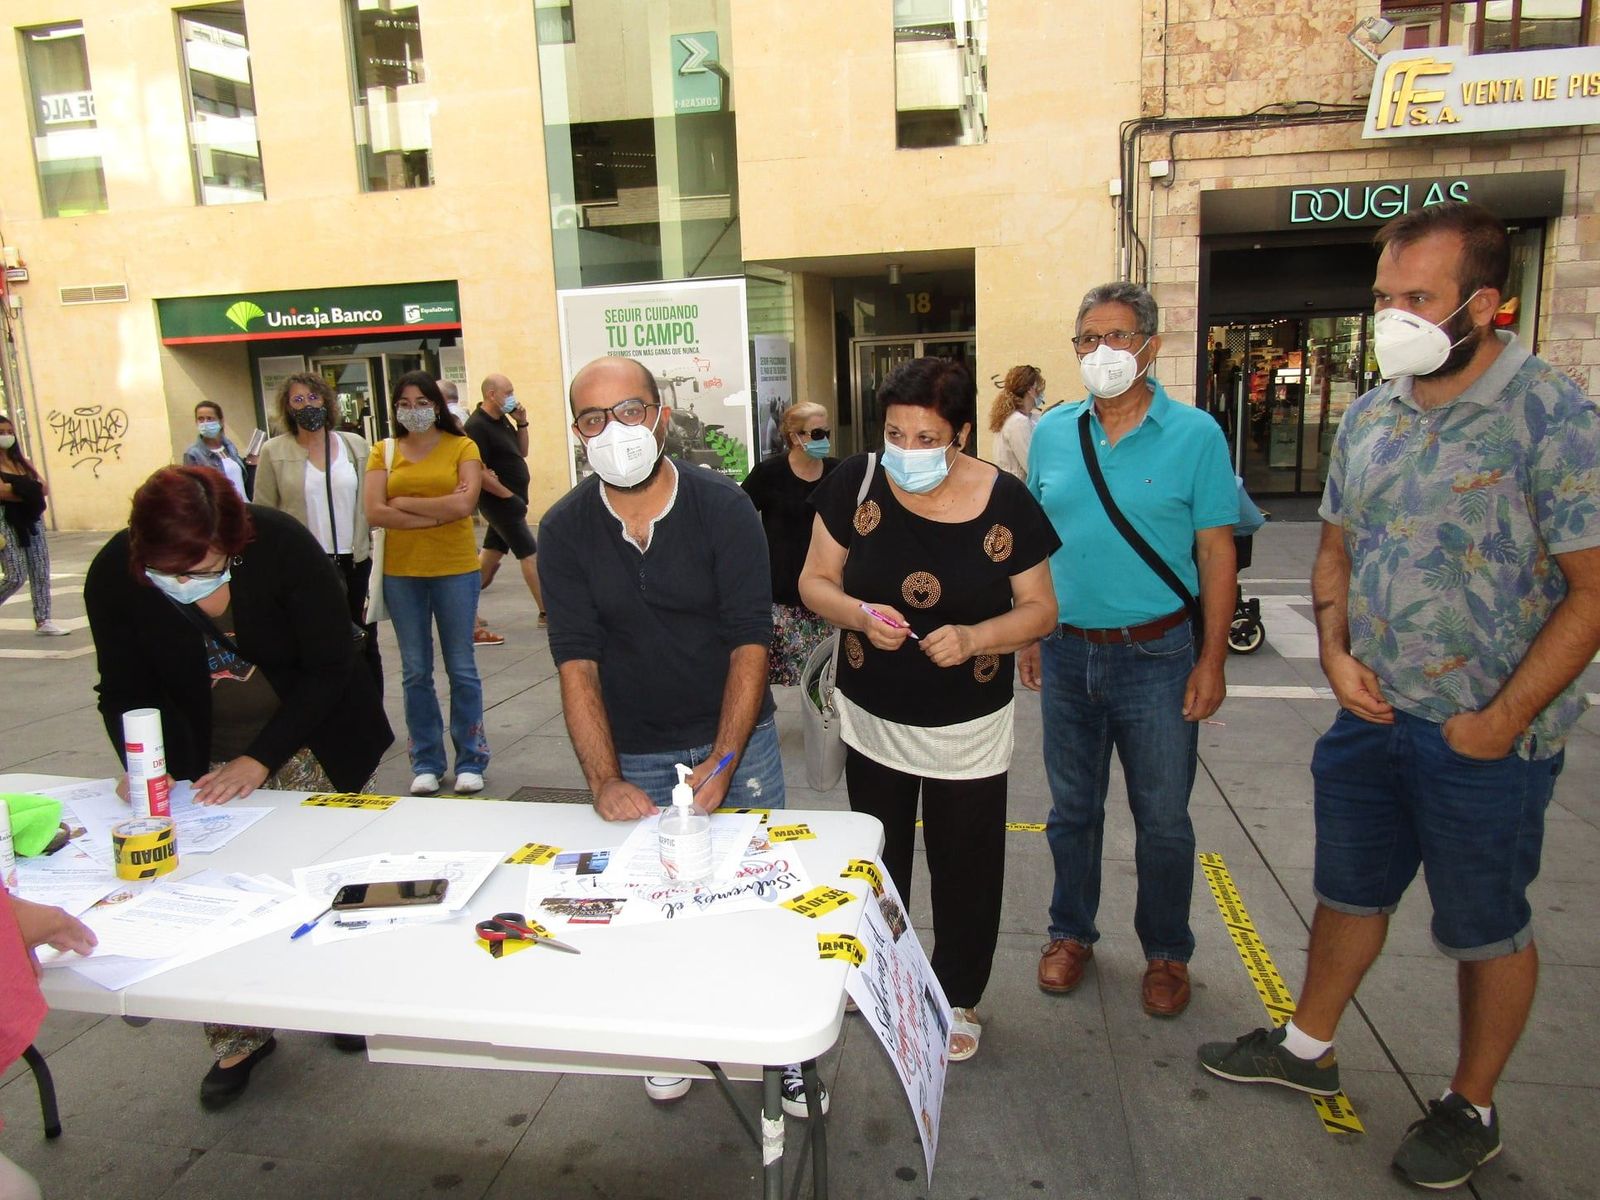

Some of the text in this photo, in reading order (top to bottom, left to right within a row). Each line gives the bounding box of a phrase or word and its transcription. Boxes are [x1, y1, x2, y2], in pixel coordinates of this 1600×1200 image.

[1462, 76, 1524, 106] VENTA
[1533, 74, 1558, 101] DE
[906, 292, 931, 314] 18
[267, 307, 383, 328] Unicaja Banco
[605, 304, 699, 324] SEGUIR CUIDANDO
[605, 321, 700, 348] TU CAMPO.
[774, 828, 811, 838] MANT
[661, 902, 685, 919] el
